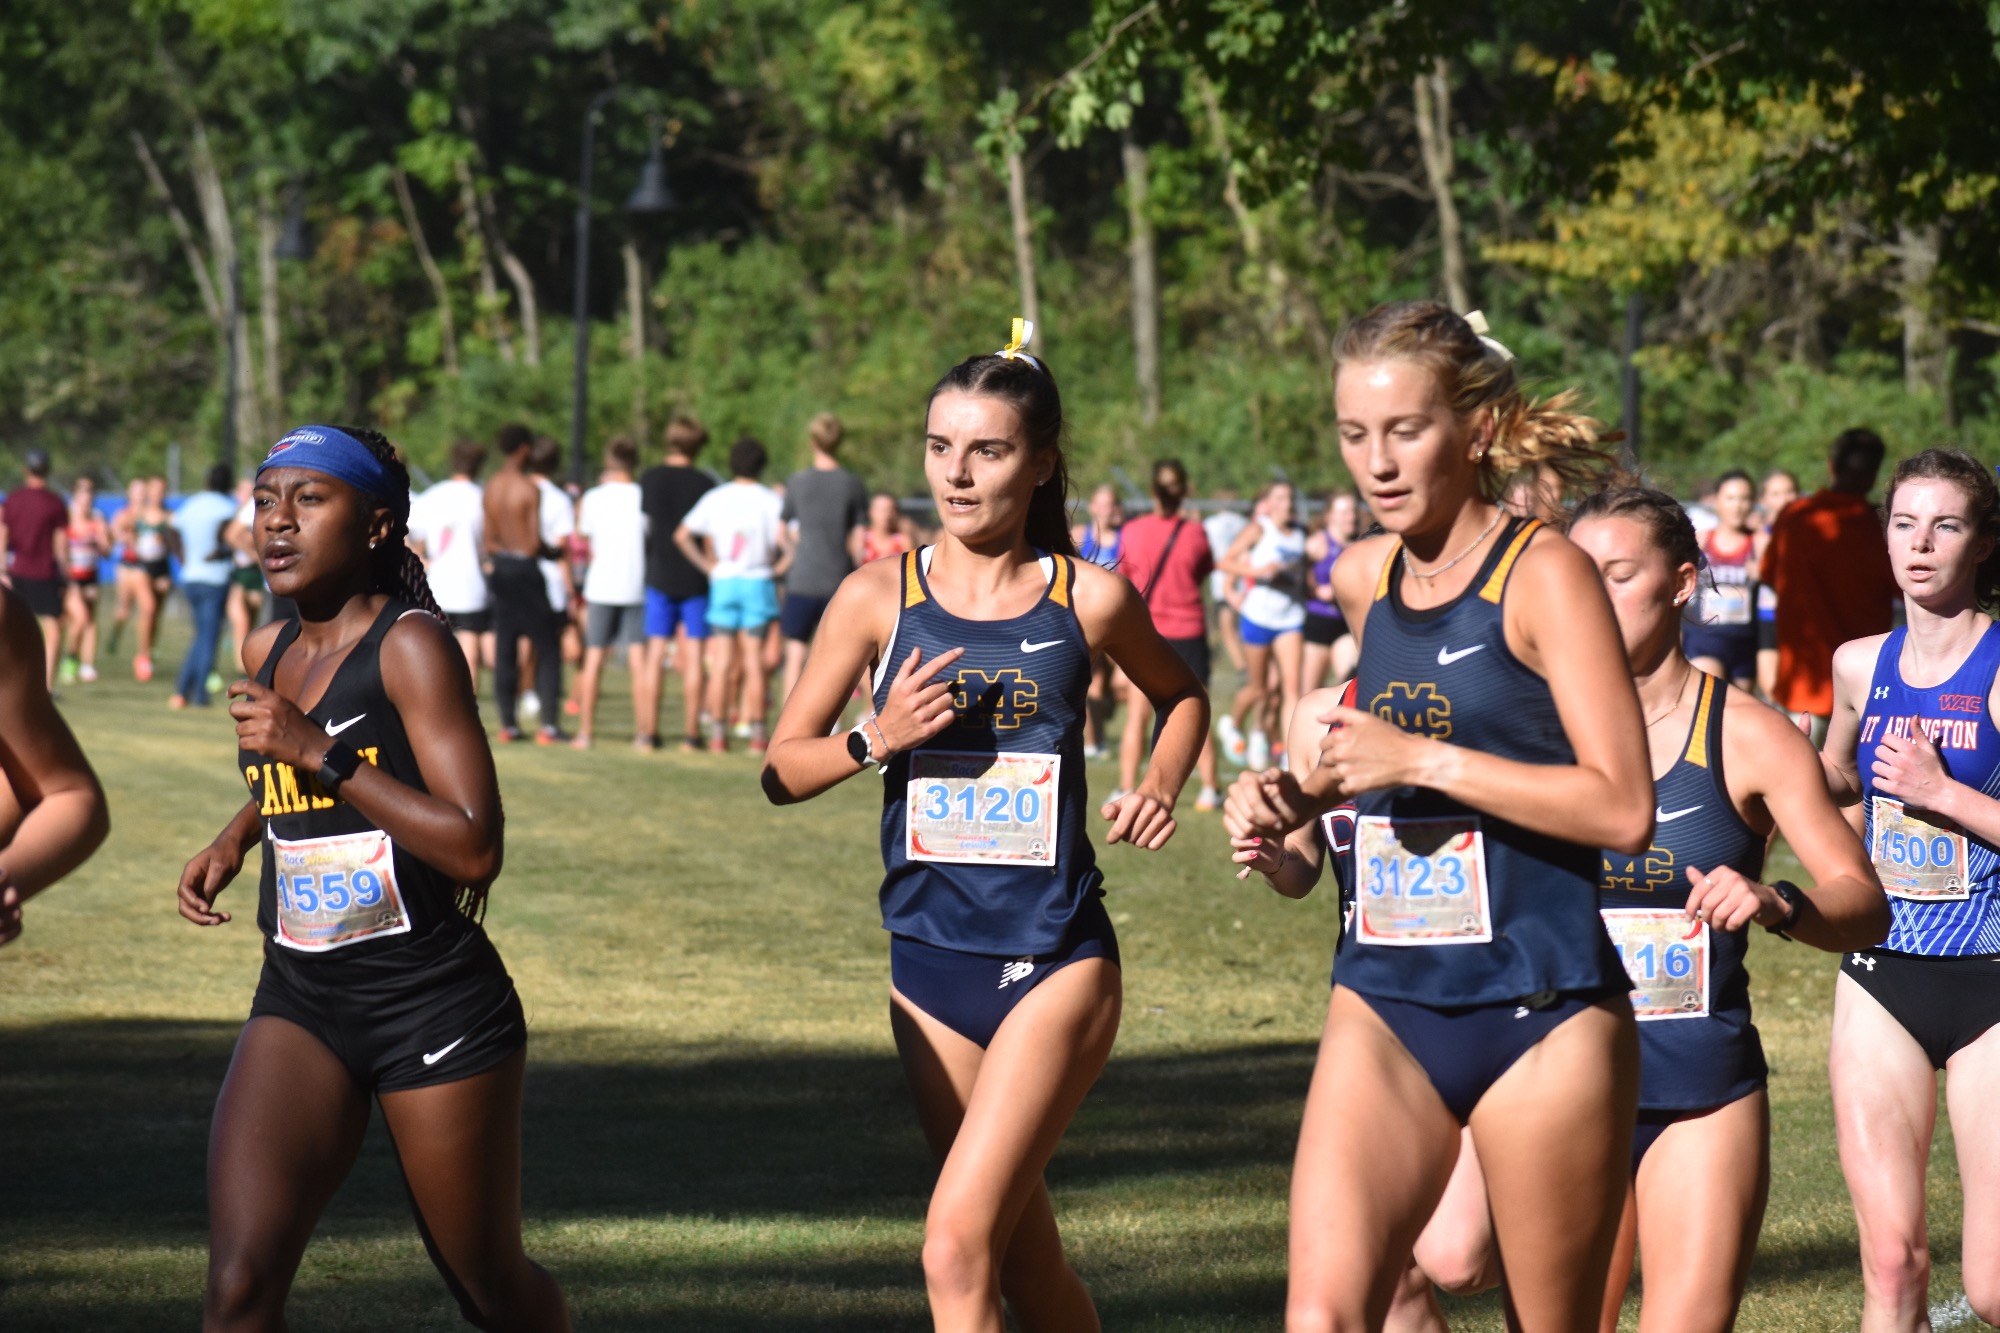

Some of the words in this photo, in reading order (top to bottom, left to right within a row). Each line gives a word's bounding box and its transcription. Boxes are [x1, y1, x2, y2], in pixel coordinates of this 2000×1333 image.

[1939, 695, 1982, 712] WAC
[1882, 716, 1979, 750] ARLNGTON
[924, 783, 1041, 824] 3120
[1880, 827, 1955, 868] 1500
[278, 868, 382, 913] 1559
[1368, 856, 1467, 896] 3123
